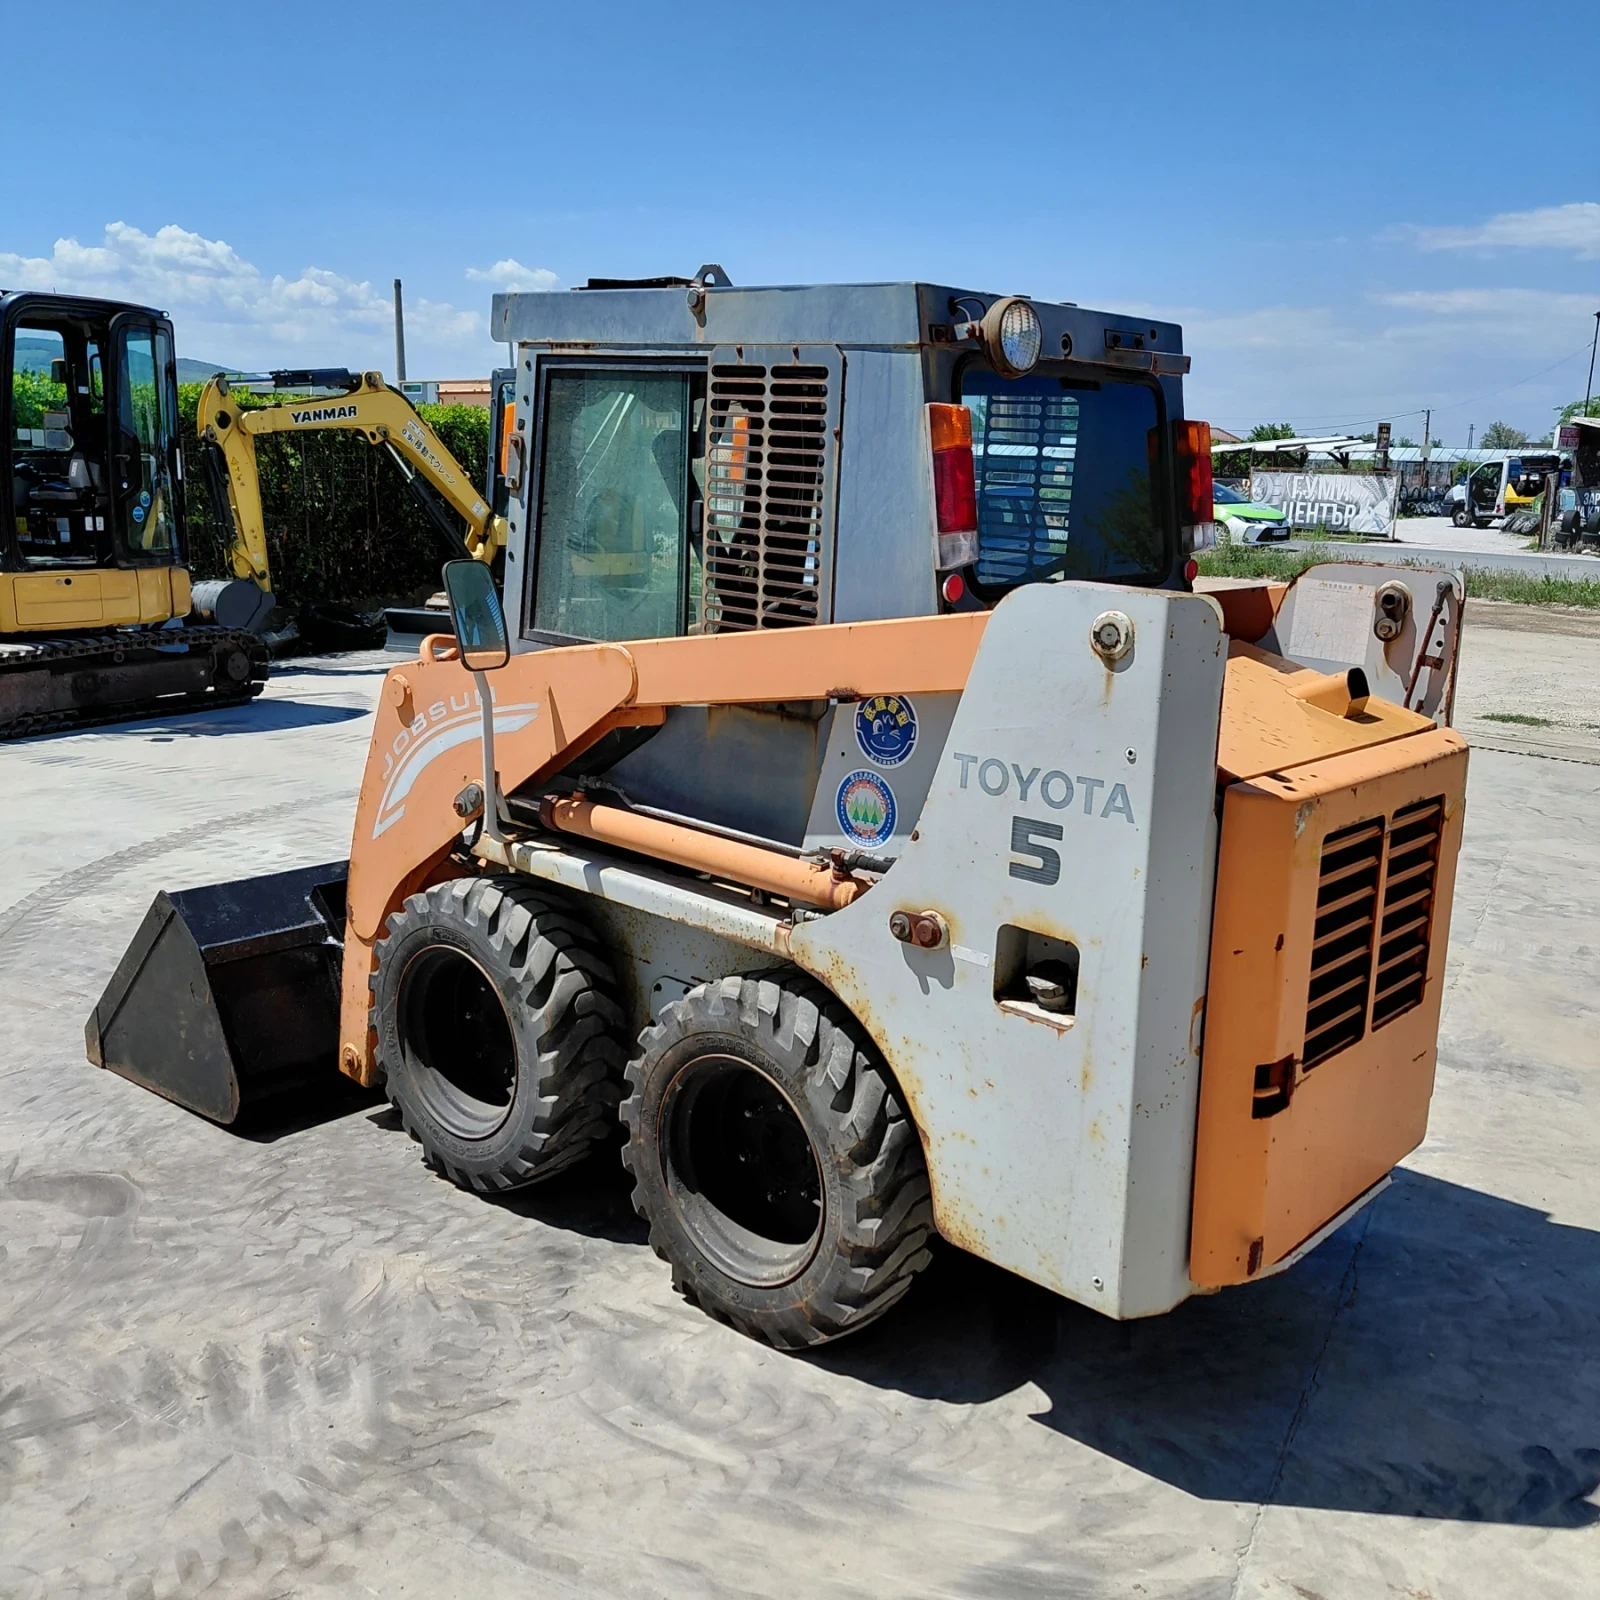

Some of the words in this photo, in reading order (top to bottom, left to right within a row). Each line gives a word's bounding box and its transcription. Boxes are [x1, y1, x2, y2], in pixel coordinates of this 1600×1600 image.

[291, 406, 358, 424] YANMAR
[1282, 500, 1357, 526] ЦЕНТЪР
[953, 752, 1136, 824] TOYOTA
[1008, 814, 1064, 887] 5
